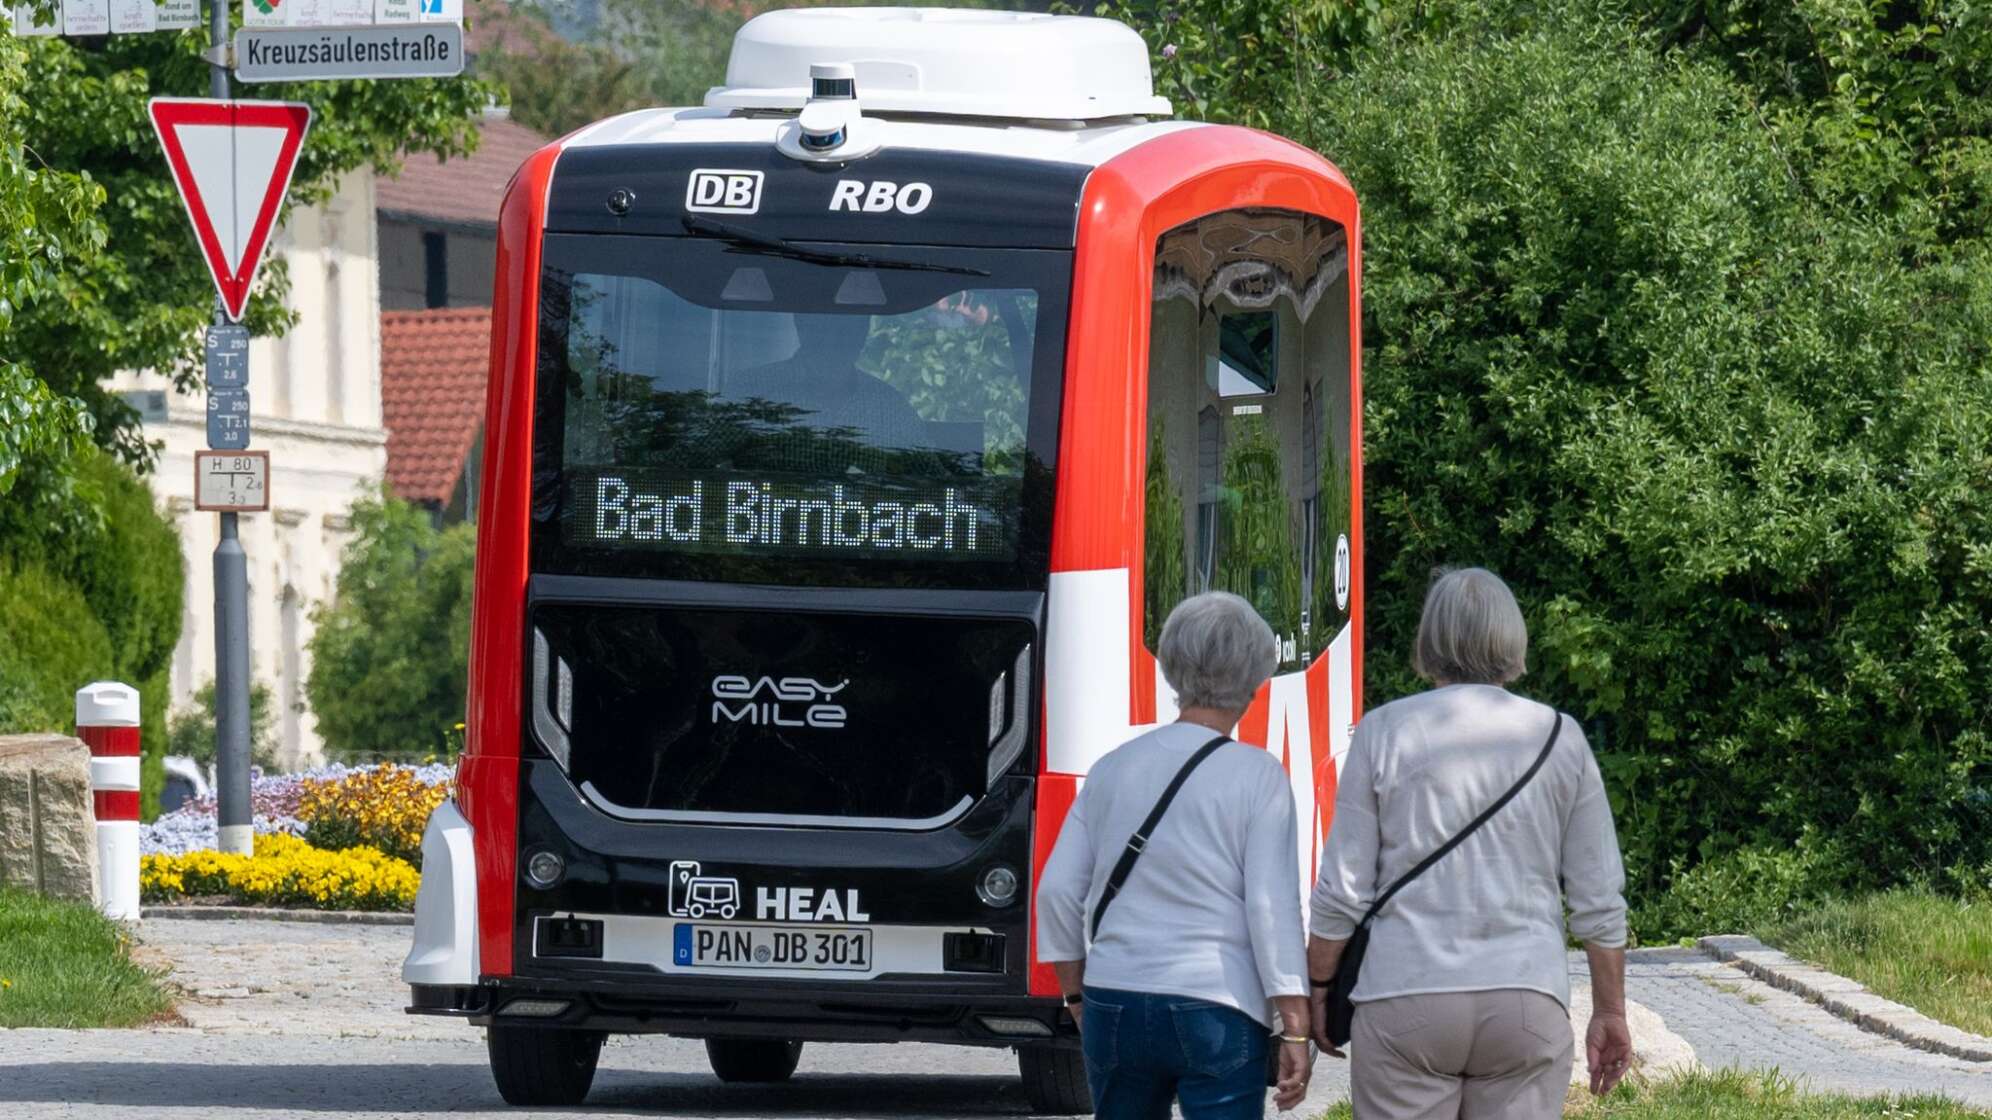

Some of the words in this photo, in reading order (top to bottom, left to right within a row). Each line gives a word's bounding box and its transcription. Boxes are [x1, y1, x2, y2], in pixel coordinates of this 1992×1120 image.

[248, 34, 449, 65] Kreuzsäulenstraße
[695, 174, 754, 206] DB
[828, 179, 934, 214] RBO
[208, 334, 218, 349] S
[231, 339, 247, 349] 250
[209, 397, 219, 411] S
[232, 402, 248, 411] 250
[212, 459, 222, 471] H
[233, 458, 251, 471] 80
[596, 477, 702, 541] Bad
[726, 481, 978, 550] Birnbach
[756, 886, 870, 922] HEAL
[679, 948, 688, 959] D
[697, 929, 752, 962] PAN
[772, 932, 808, 963] DB
[814, 933, 867, 965] 301
